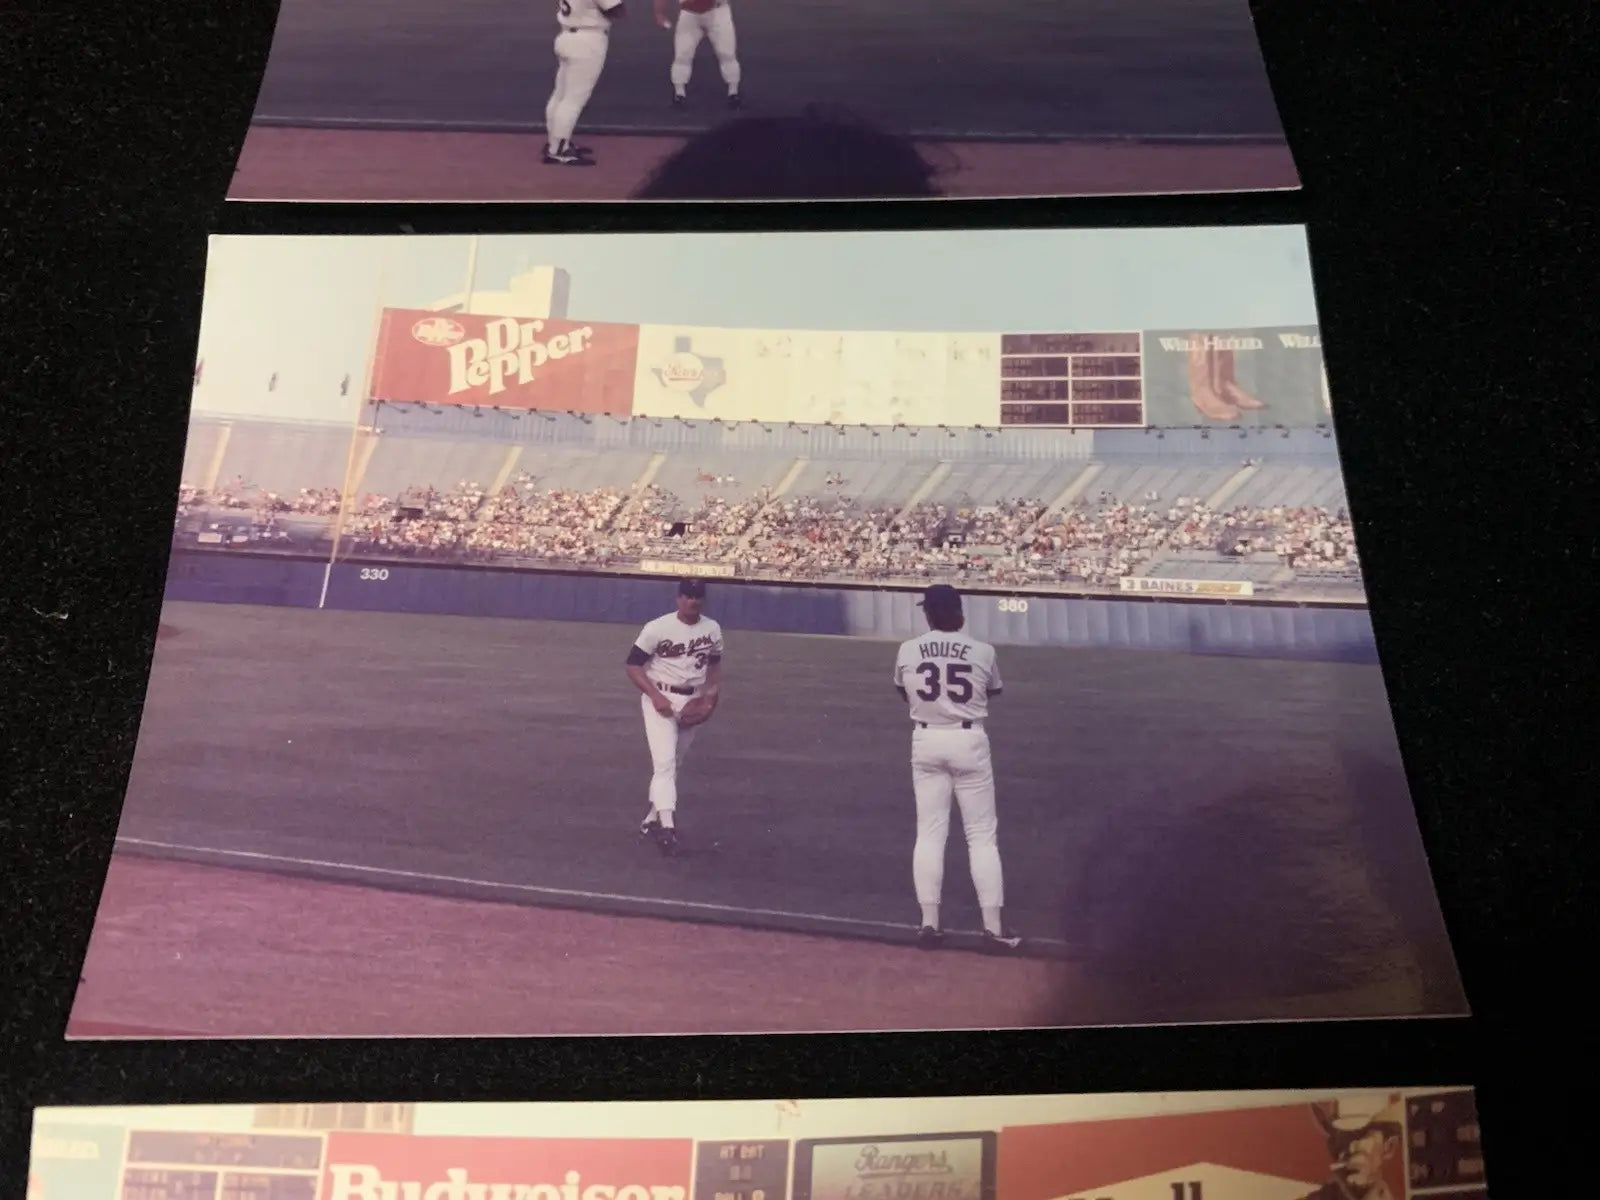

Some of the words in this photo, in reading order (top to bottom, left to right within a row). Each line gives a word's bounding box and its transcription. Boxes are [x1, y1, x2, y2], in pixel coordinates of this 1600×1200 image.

[485, 318, 545, 357] Dr
[447, 326, 593, 395] Pepper
[360, 567, 389, 580] 330
[1140, 580, 1194, 592] BAINES
[918, 641, 972, 661] HOUSE
[915, 662, 973, 704] 35
